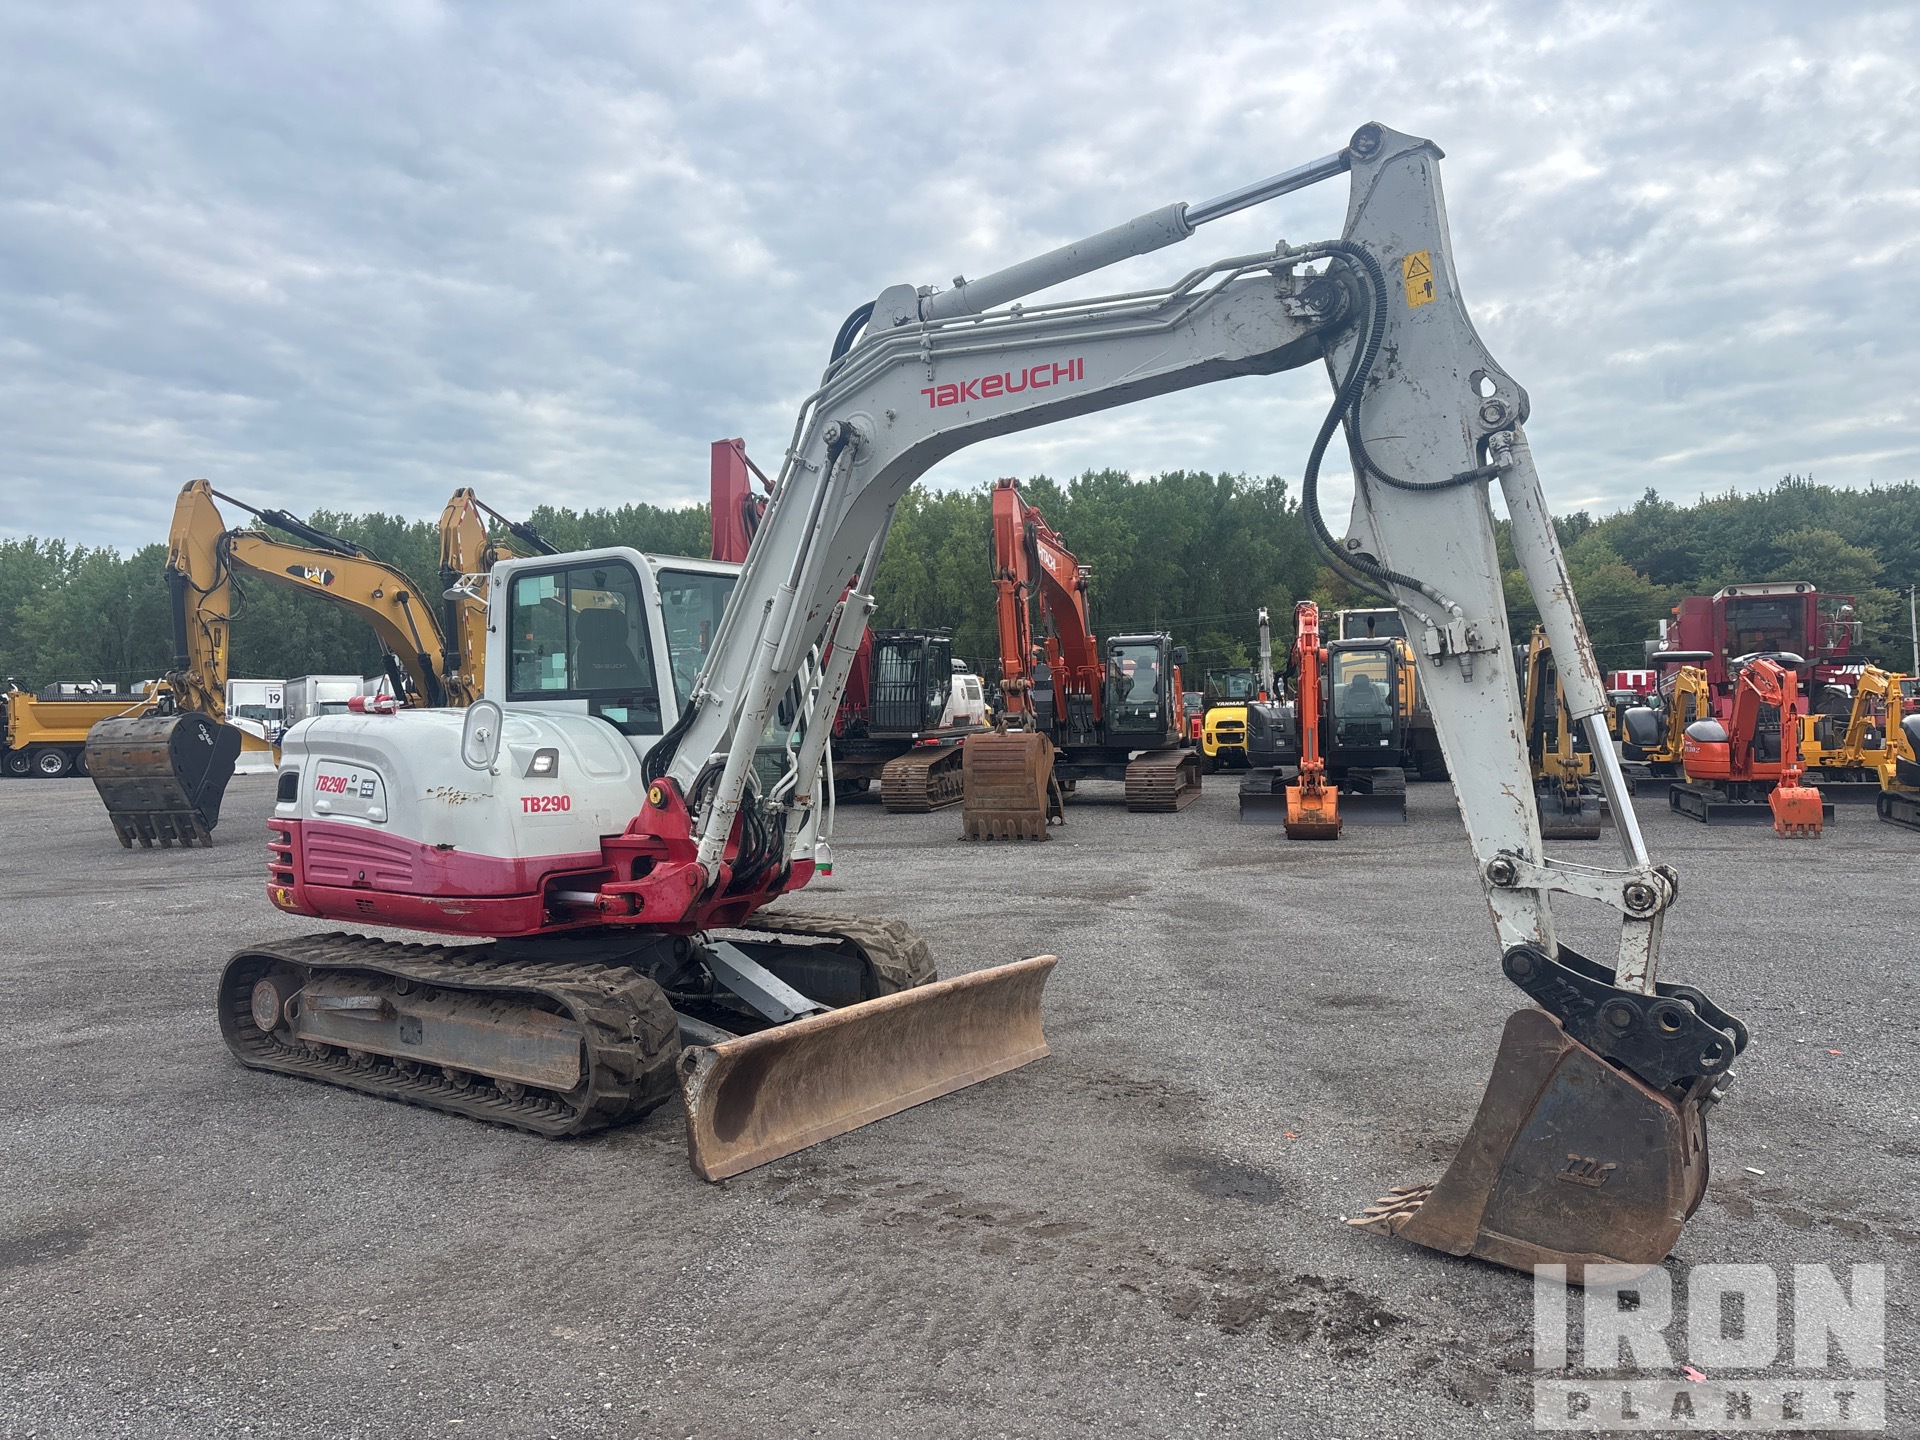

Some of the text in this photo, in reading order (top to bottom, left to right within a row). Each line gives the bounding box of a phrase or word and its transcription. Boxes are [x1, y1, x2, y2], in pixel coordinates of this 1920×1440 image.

[920, 357, 1084, 408] TAKEUCHI
[268, 693, 281, 704] 19
[198, 723, 214, 746] CRAIG
[315, 775, 348, 794] TB290
[520, 795, 571, 813] TB290
